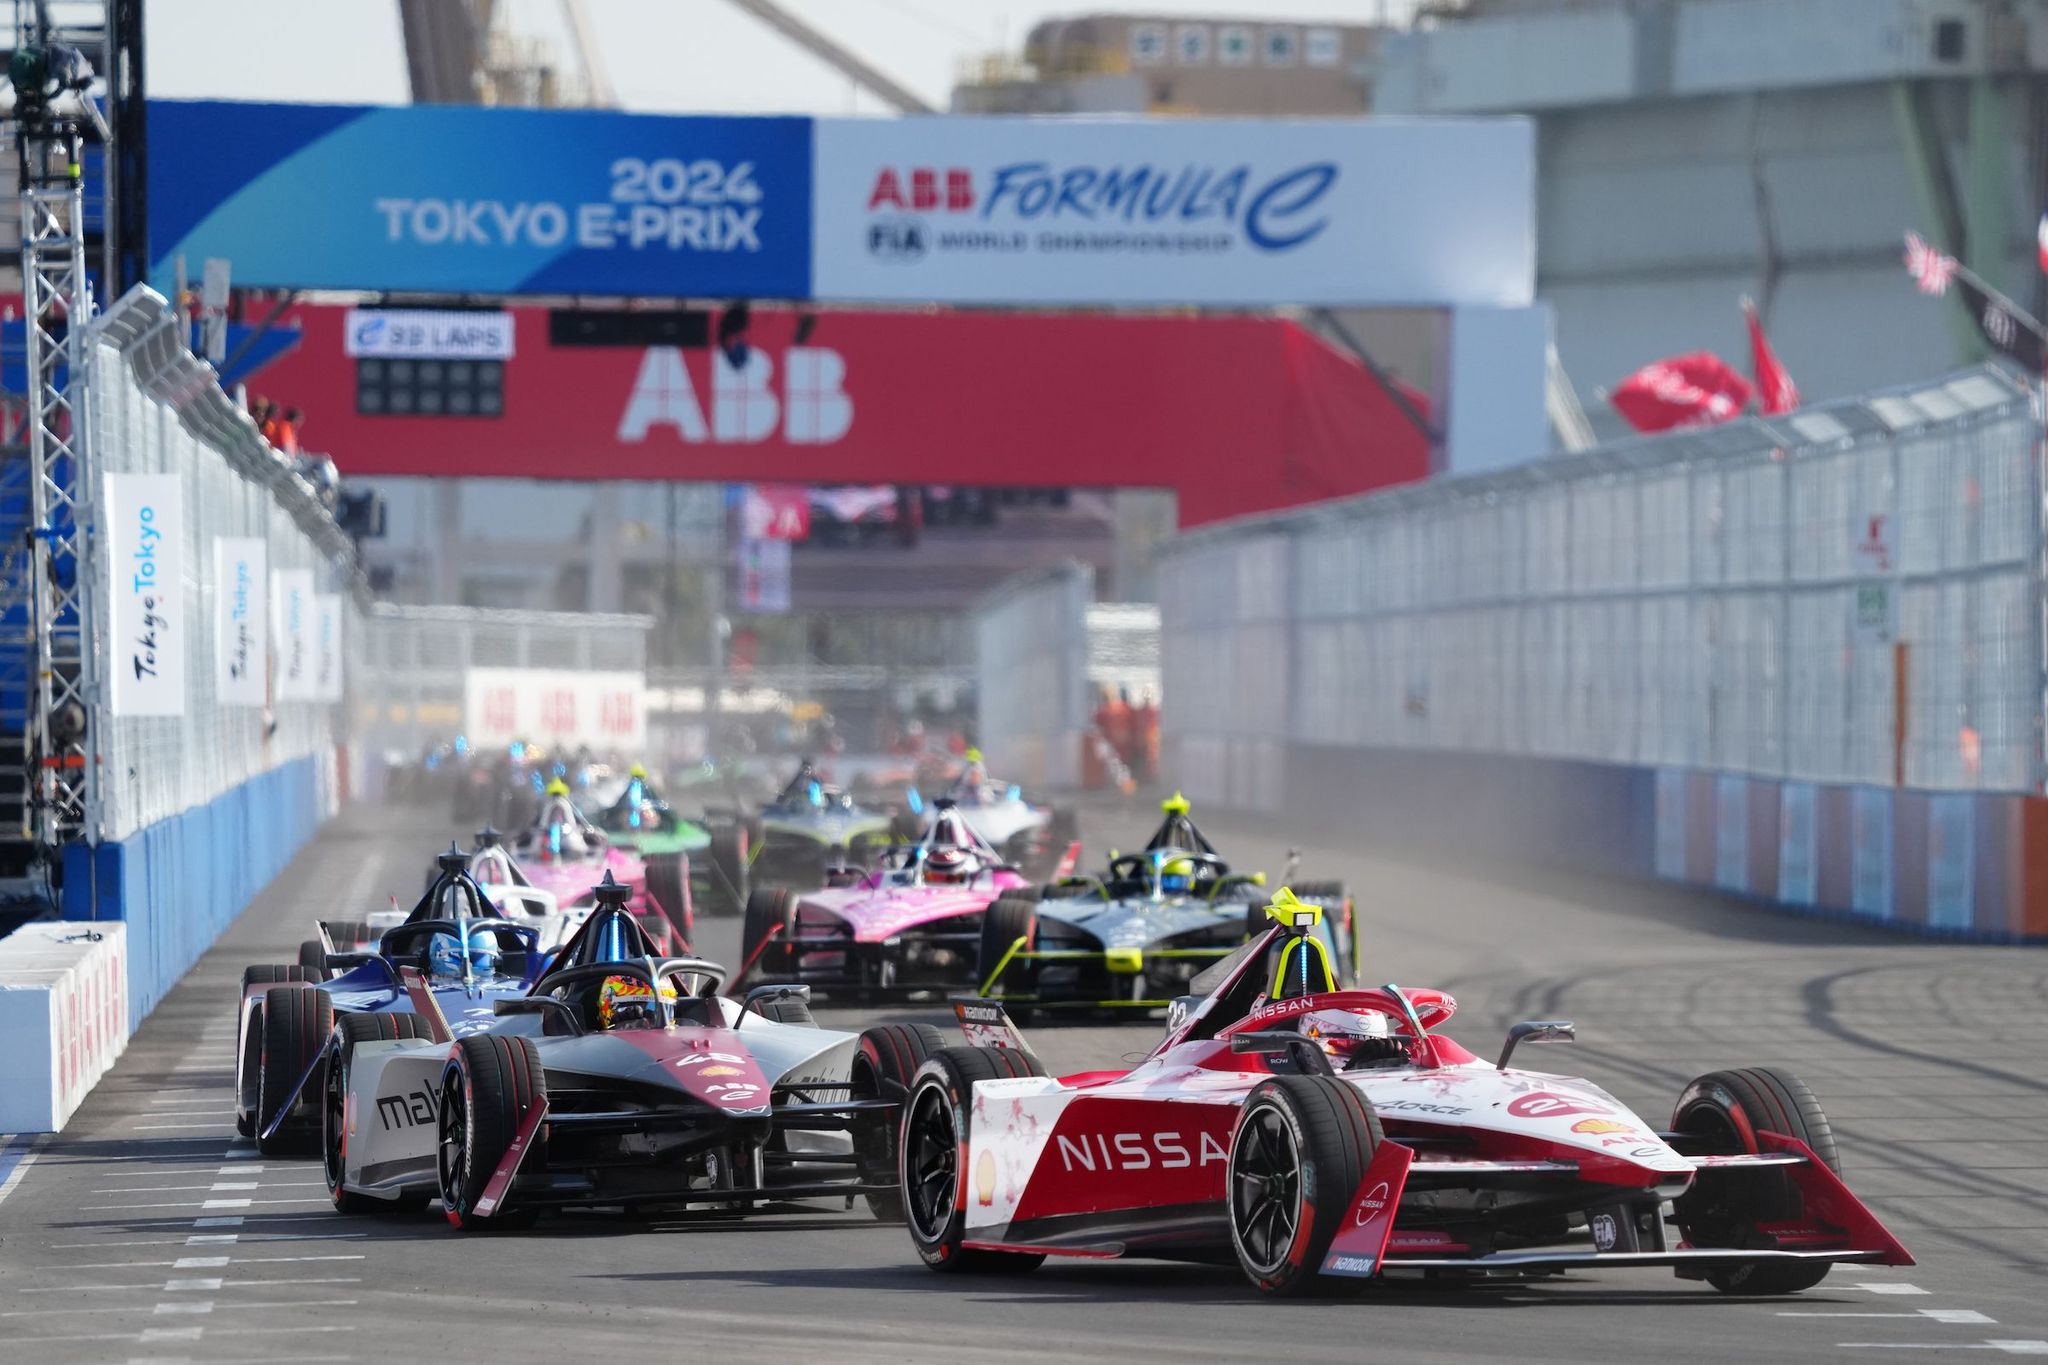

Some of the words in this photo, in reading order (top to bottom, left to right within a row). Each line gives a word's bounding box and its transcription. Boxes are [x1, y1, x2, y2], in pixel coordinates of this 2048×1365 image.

[610, 158, 762, 202] 2024
[867, 166, 976, 213] ABB
[980, 160, 1250, 222] FORMULA
[377, 198, 567, 246] TOKYO
[578, 203, 763, 252] E-PRIX
[868, 221, 928, 257] FIA
[938, 230, 1028, 255] WORLD
[1037, 230, 1236, 256] CHAMPIONSHIP
[431, 326, 502, 348] LAPS
[617, 344, 855, 444] ABB
[133, 506, 161, 594] Tokyo
[133, 596, 168, 681] Tokyo
[1254, 997, 1314, 1021] NISSAN
[705, 1082, 761, 1094] ABB
[1056, 1131, 1234, 1171] NISSA
[1359, 1200, 1386, 1209] NISSAN
